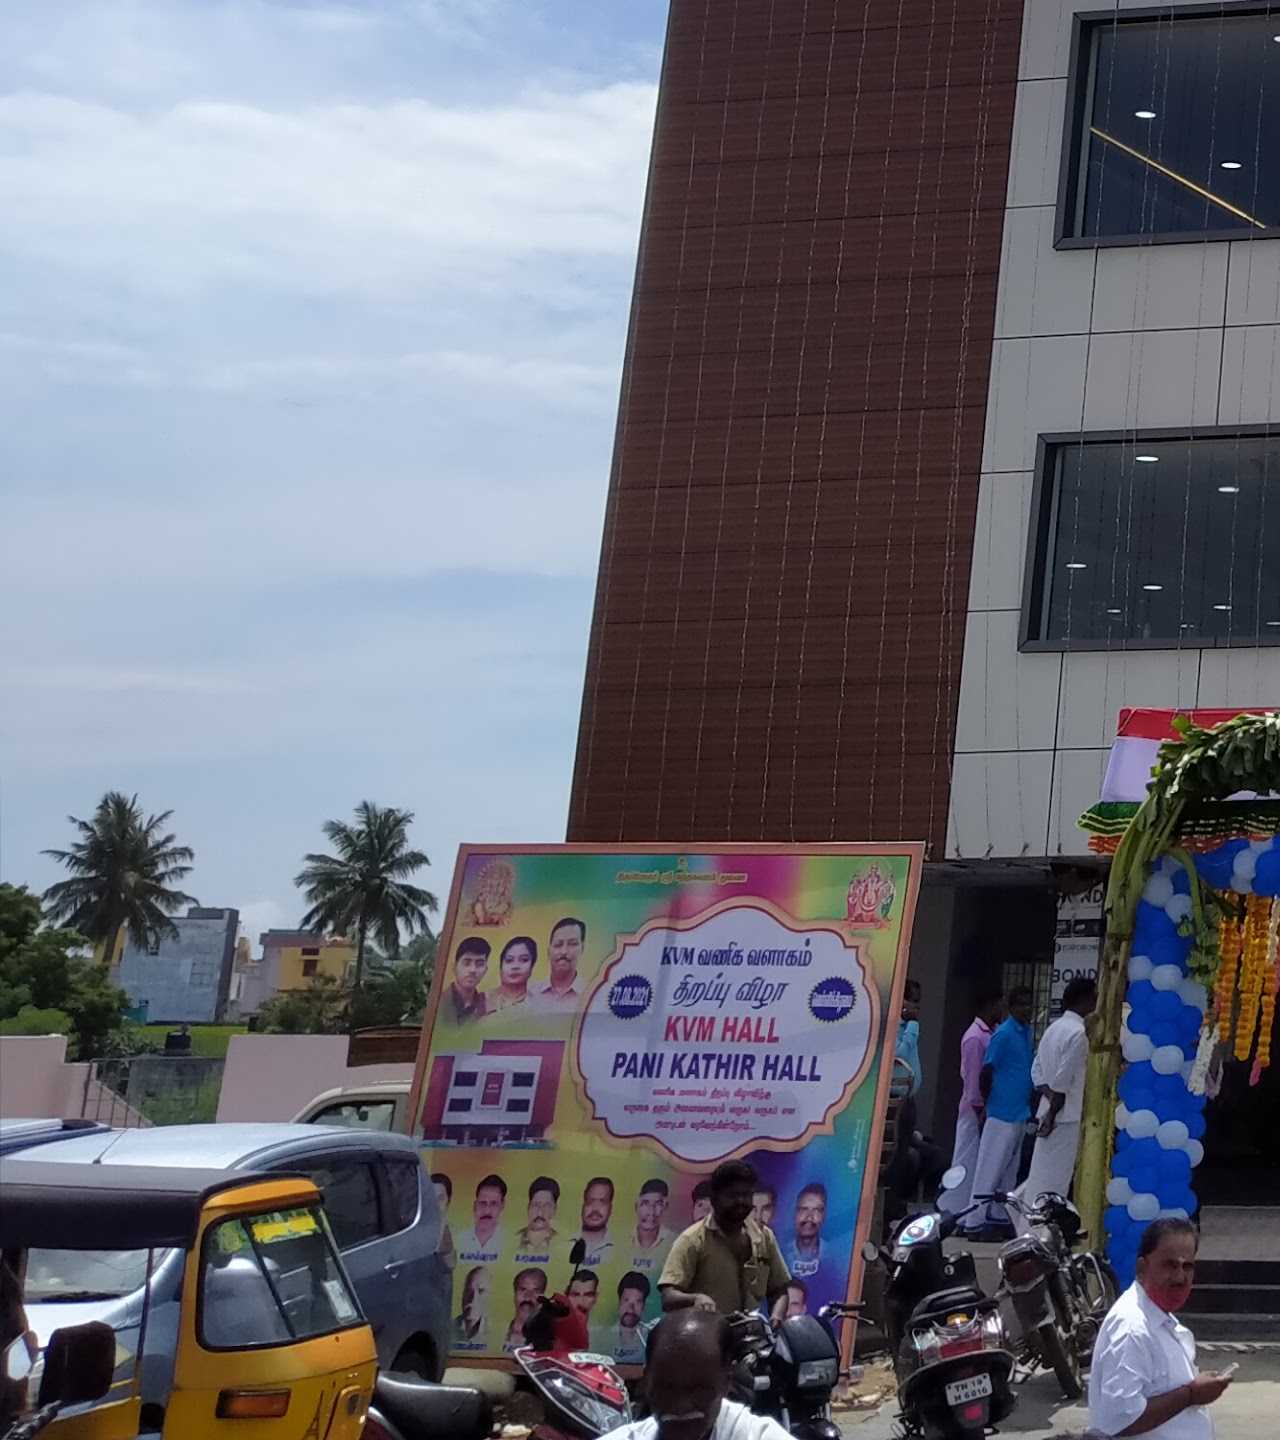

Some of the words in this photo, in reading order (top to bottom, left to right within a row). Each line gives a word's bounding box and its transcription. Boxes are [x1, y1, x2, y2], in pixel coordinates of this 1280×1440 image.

[661, 946, 694, 966] KVM
[697, 941, 745, 966] வணிக
[747, 938, 812, 967] வளாகம்
[669, 972, 730, 1008] திறப்பு
[735, 976, 791, 1009] விழா
[664, 1016, 716, 1042] KVM
[720, 1017, 780, 1044] HALL
[611, 1052, 664, 1079] PANI
[669, 1053, 756, 1081] KATHIR
[761, 1054, 822, 1082] HALL
[954, 1382, 968, 1392] TN
